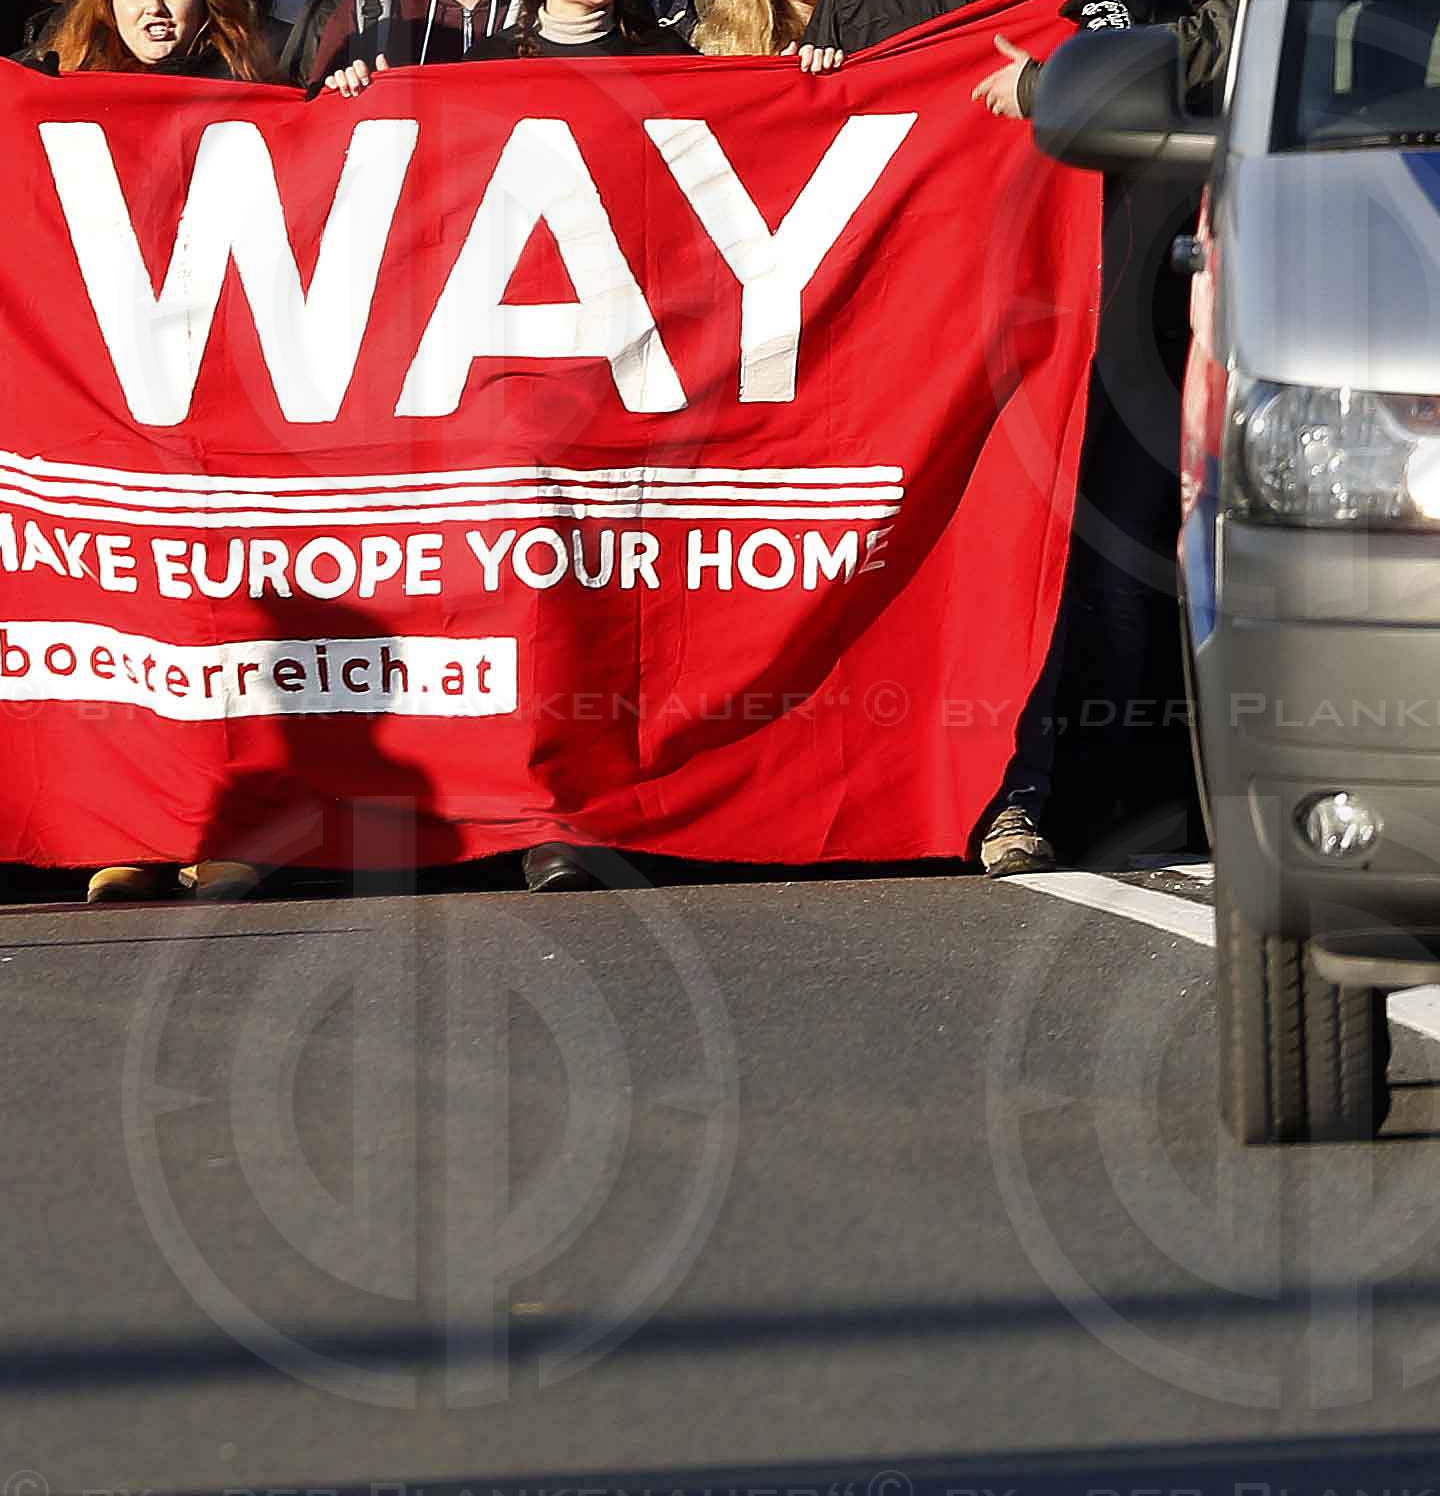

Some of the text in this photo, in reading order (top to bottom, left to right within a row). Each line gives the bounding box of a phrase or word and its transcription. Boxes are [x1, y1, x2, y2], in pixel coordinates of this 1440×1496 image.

[38, 111, 919, 427] WAY
[150, 534, 444, 600] EUROPE
[465, 526, 661, 592] YOUR
[687, 524, 896, 591] HOME
